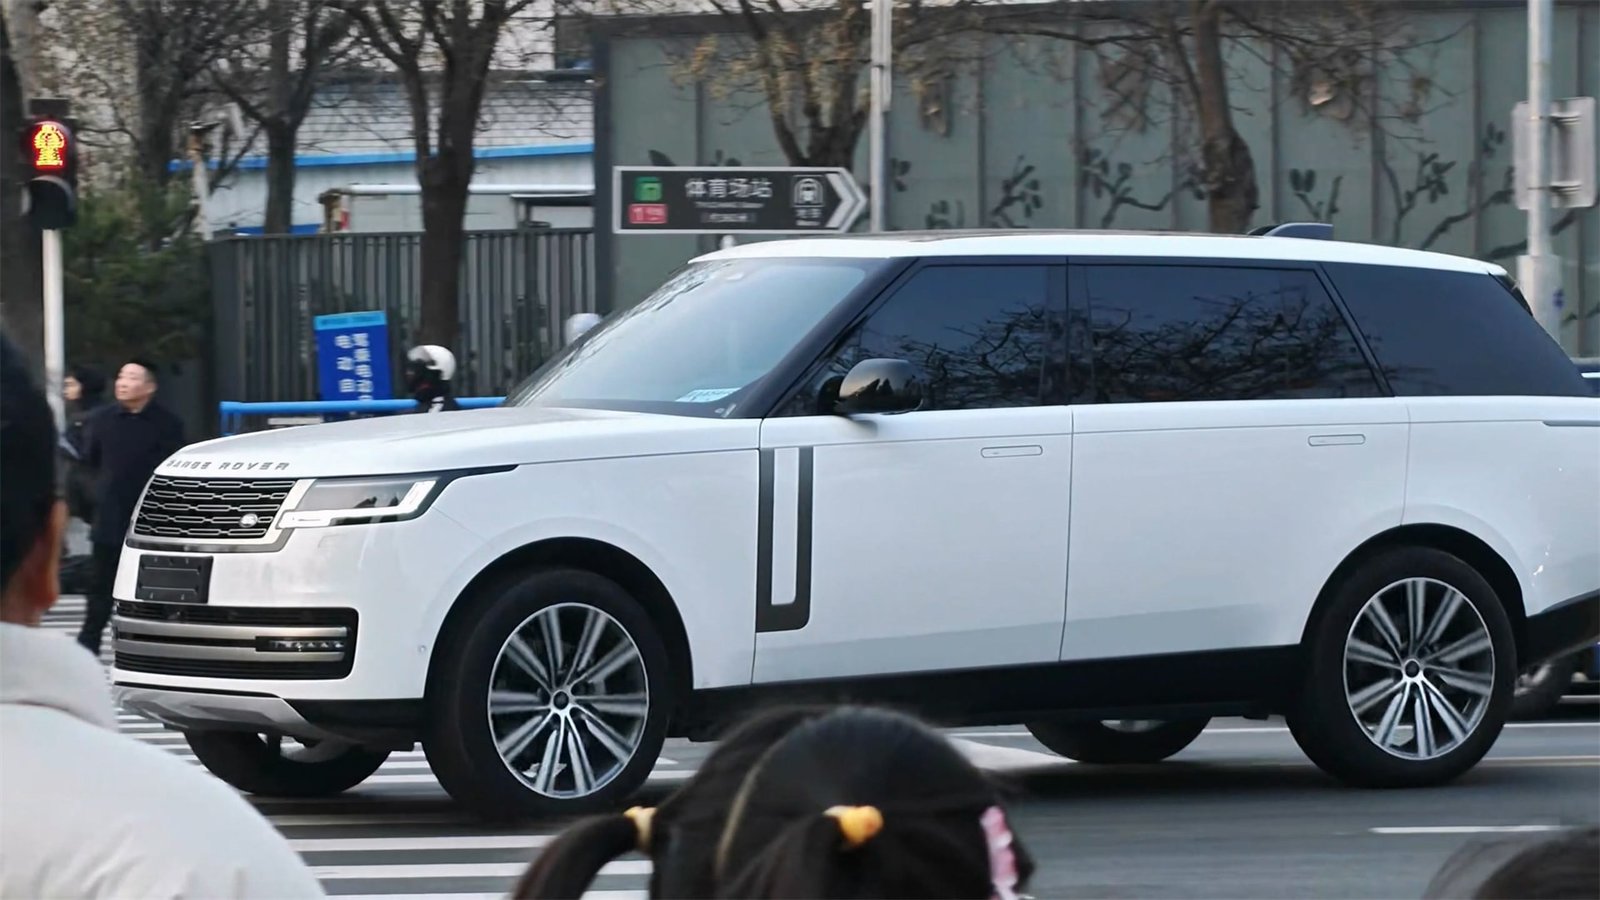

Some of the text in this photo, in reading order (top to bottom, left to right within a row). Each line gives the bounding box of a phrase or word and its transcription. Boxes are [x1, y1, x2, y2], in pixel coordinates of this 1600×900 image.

[685, 178, 773, 198] 体育场站
[166, 460, 290, 471] RANGE ROVER
